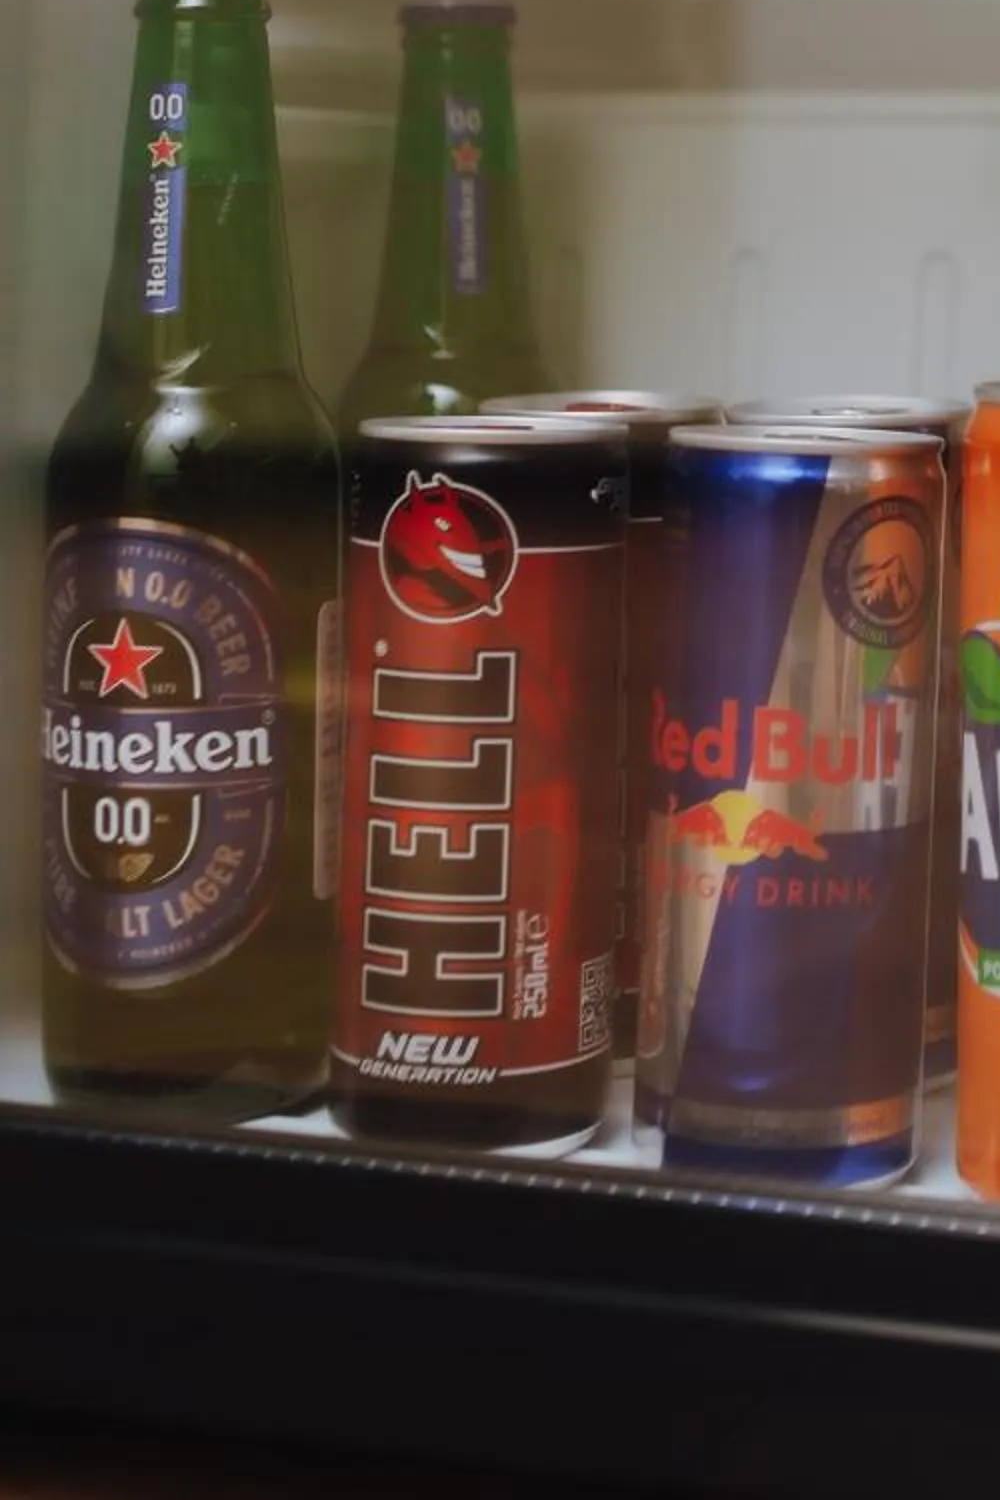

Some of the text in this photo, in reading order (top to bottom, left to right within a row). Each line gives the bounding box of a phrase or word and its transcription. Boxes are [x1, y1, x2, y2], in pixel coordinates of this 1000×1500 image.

[149, 93, 184, 121] 0.0
[146, 178, 170, 298] Heineken
[195, 593, 250, 677] BEER
[752, 702, 900, 786] Bull
[94, 796, 152, 846] 0.0
[361, 650, 517, 1018] HELL
[121, 844, 245, 938] LT LAGER
[756, 873, 876, 907] DRINK
[359, 1059, 497, 1086] GENERATION
[377, 1031, 480, 1067] NEW
